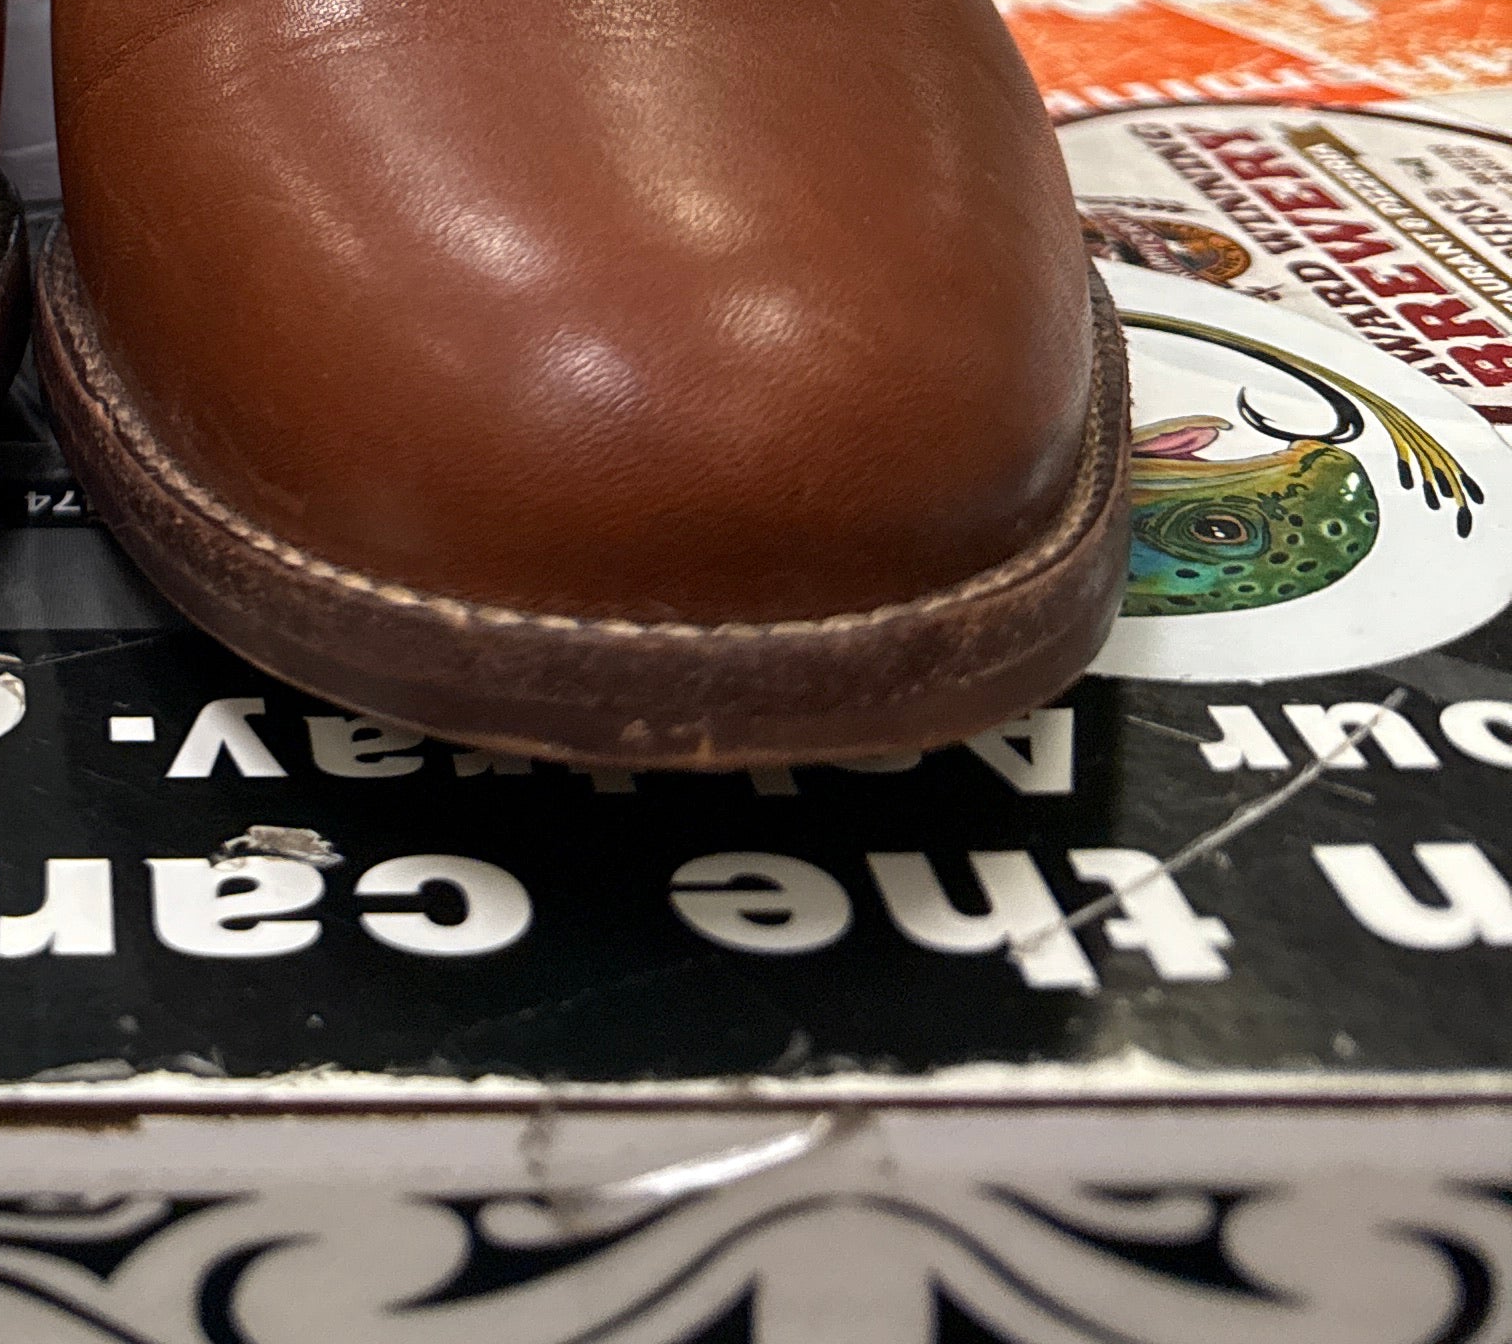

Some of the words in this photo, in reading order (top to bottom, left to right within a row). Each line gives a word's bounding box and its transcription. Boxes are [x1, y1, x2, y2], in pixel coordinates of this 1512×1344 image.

[1125, 122, 1305, 256] WINNING
[1176, 122, 1512, 388] BREWERY
[1289, 259, 1473, 388] AWARD
[108, 696, 1075, 796] Aay.
[668, 848, 1236, 992] the
